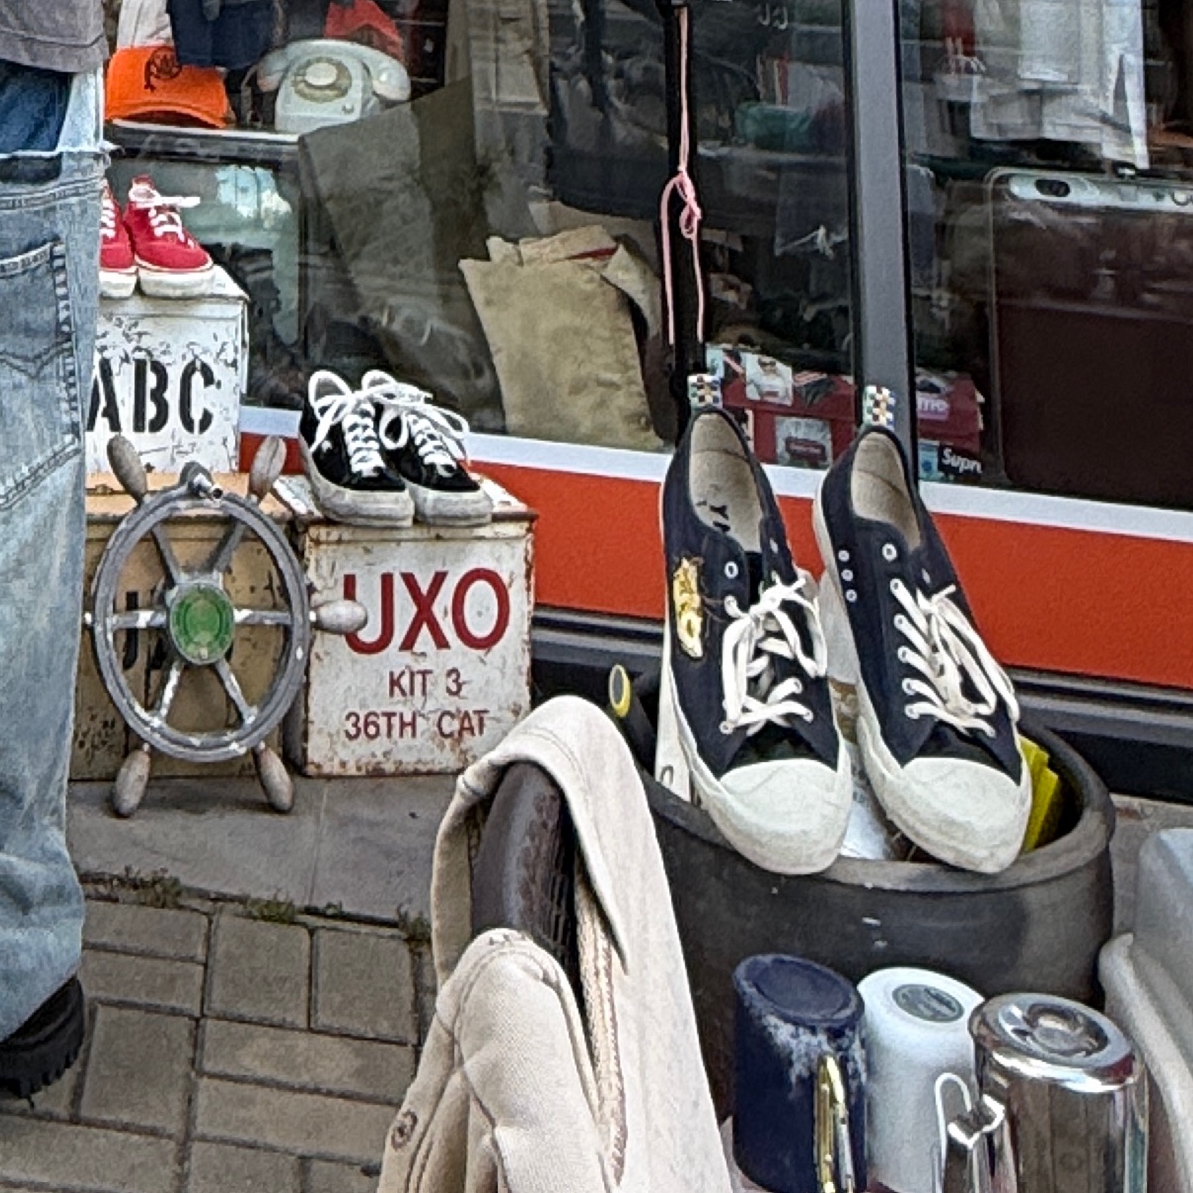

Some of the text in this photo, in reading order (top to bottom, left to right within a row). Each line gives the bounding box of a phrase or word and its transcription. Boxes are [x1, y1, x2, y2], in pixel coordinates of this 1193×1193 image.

[87, 356, 214, 435] ABC
[344, 568, 510, 655] UXO
[389, 668, 463, 697] KIT 3
[345, 710, 489, 741] 36TH CAT
